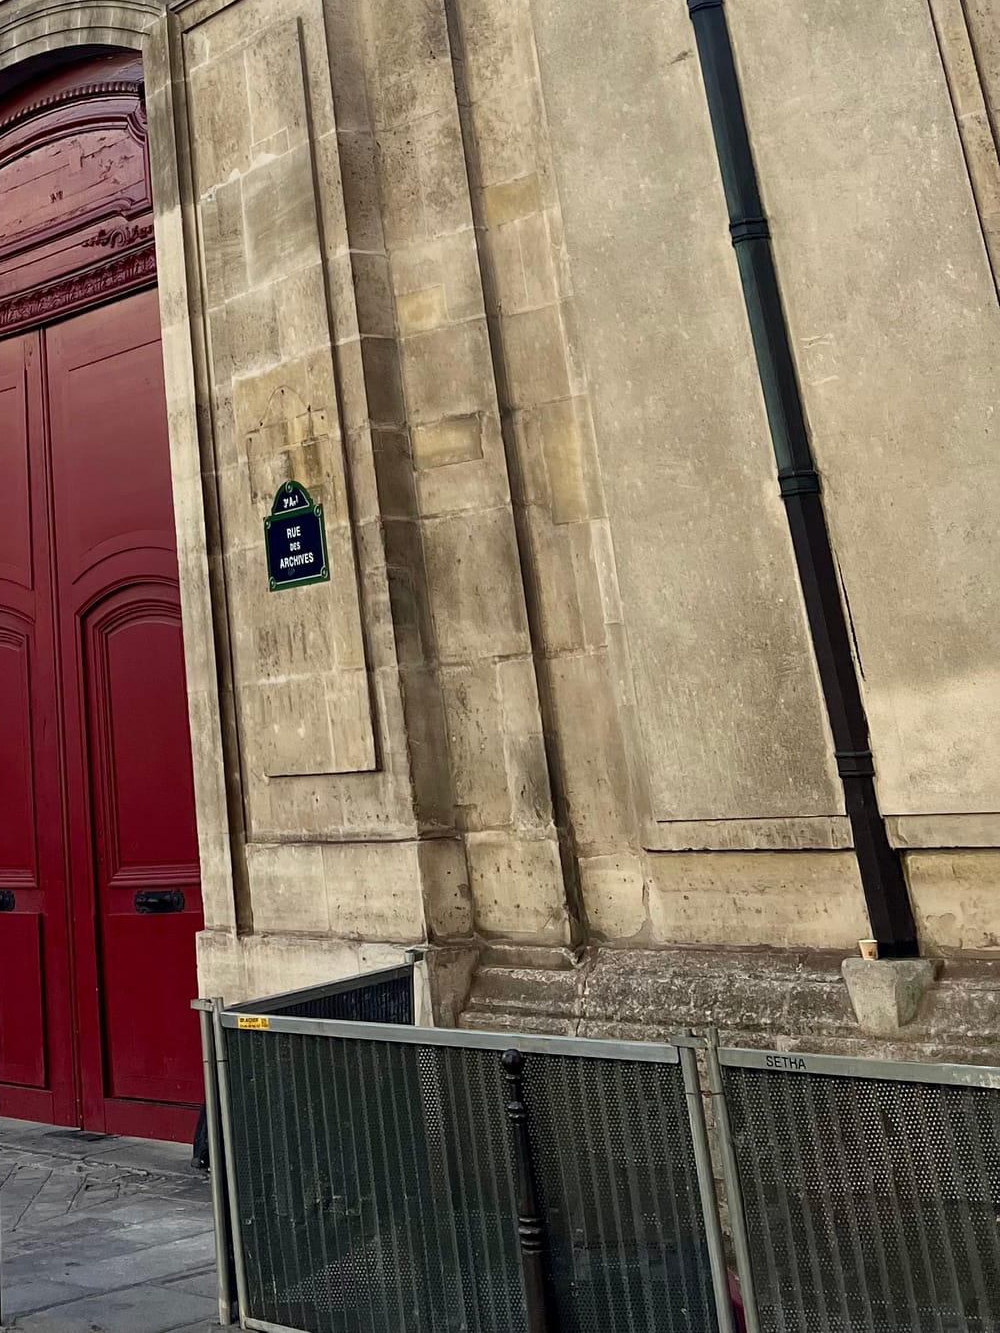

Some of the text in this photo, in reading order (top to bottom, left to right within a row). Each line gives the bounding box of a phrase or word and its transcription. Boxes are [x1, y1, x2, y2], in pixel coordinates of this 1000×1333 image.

[286, 526, 301, 539] RUE
[289, 541, 301, 552] DES
[280, 552, 314, 569] ARCHIVES
[766, 1055, 807, 1070] SETHA
